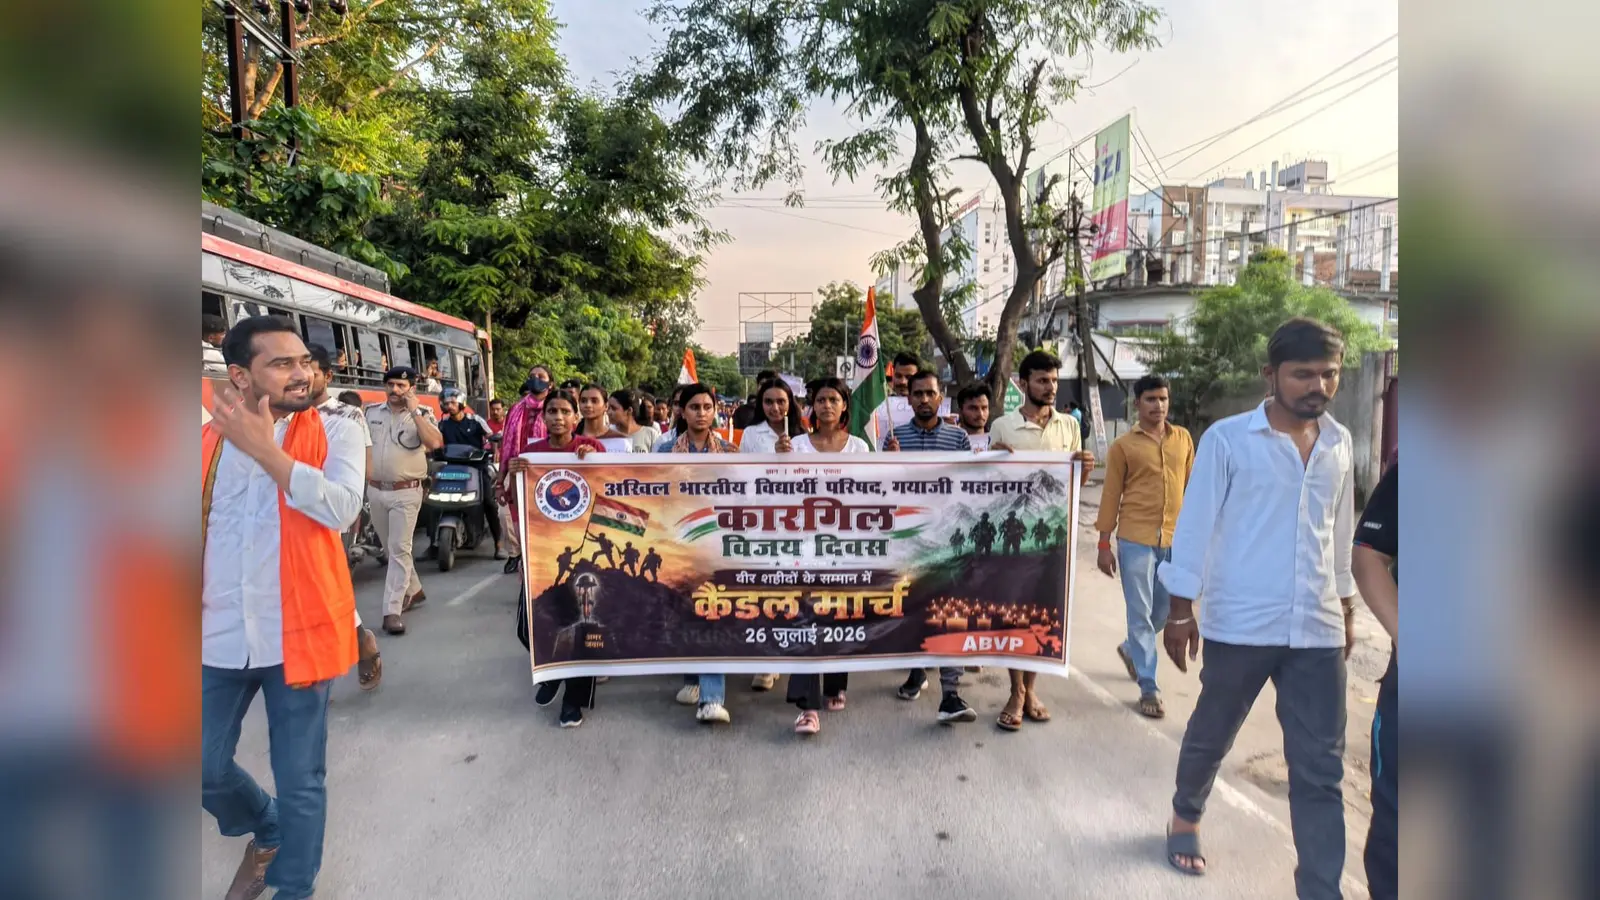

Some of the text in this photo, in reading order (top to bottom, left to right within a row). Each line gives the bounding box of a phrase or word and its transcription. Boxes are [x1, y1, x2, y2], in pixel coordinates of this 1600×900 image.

[605, 479, 670, 496] अखिल
[679, 478, 747, 495] भारतीय
[755, 478, 818, 495] विद्यार्थी
[892, 477, 954, 494] गयाजी
[960, 480, 1034, 494] महानगर
[714, 497, 897, 531] कारगिल
[722, 534, 890, 557] विजय दिवस
[736, 571, 872, 585] वीर शहीदों के सम्मान में
[811, 581, 909, 619] मार्च
[745, 623, 866, 647] 26 जुलाई 2026
[962, 635, 1024, 652] ABVP
